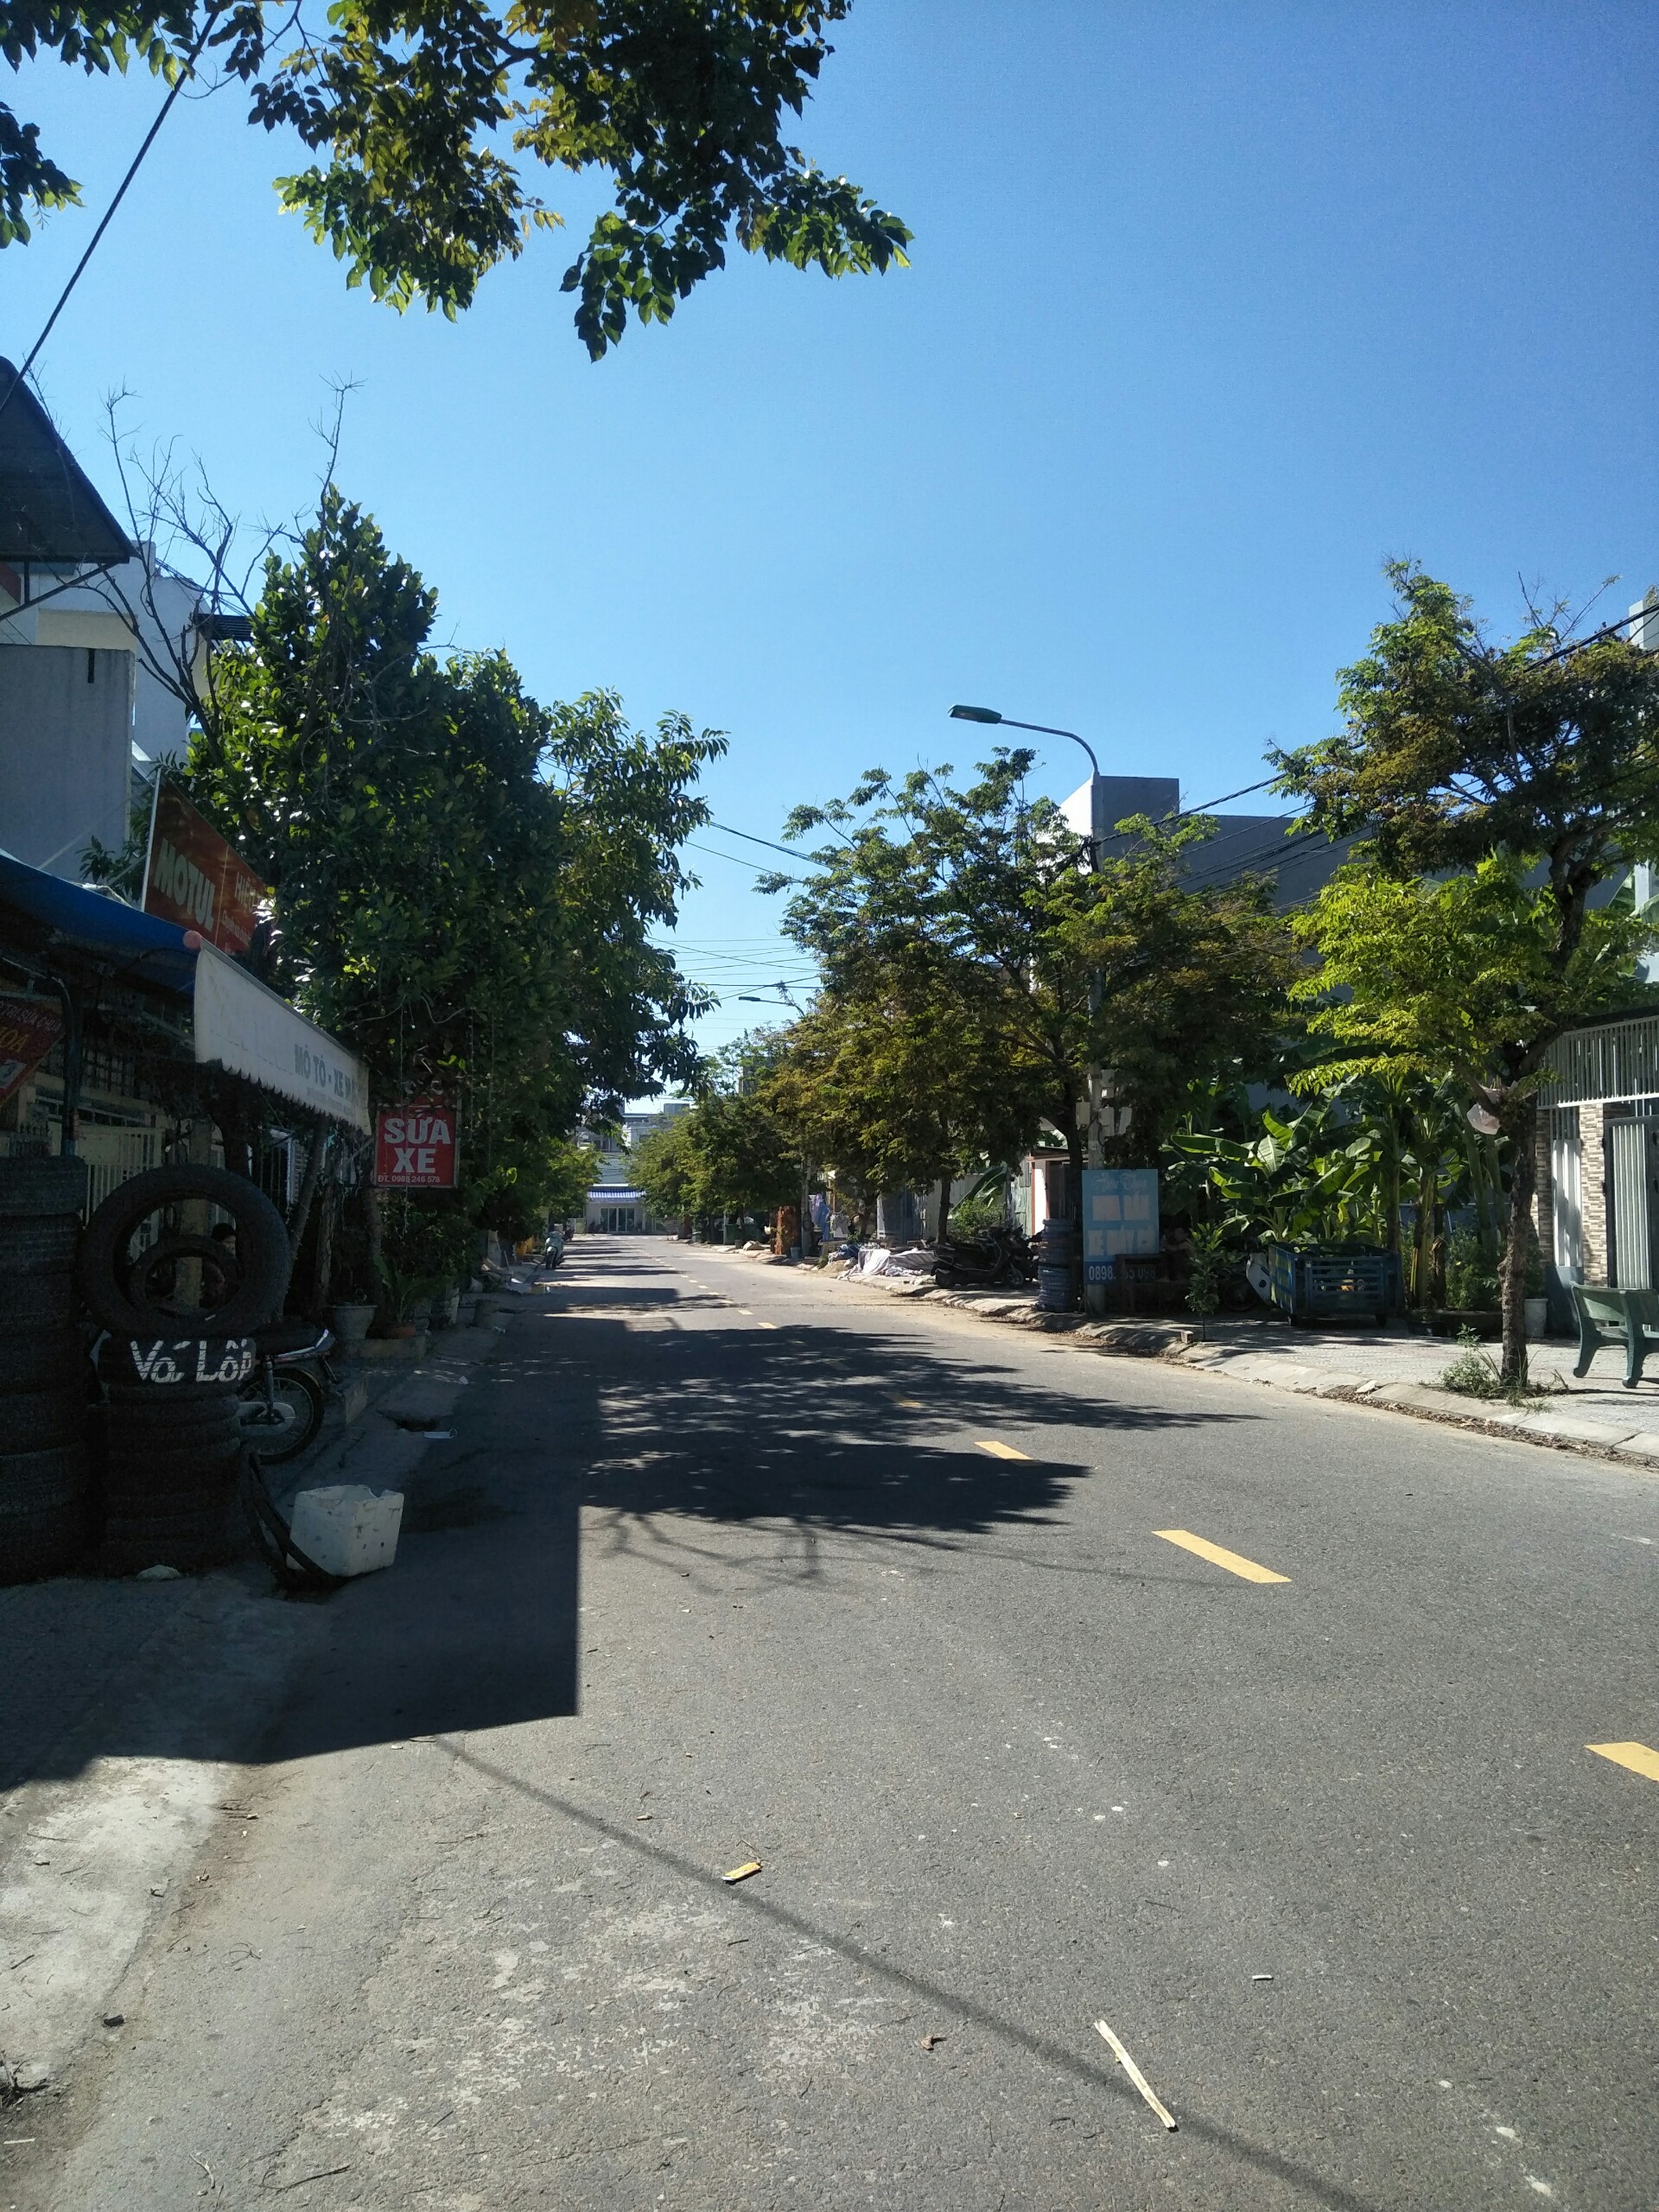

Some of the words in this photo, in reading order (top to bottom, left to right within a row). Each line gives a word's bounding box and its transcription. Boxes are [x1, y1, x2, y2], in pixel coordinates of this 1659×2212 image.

[154, 836, 215, 932] MOTUL
[313, 1054, 326, 1088] TÔ
[393, 1147, 435, 1173] XE
